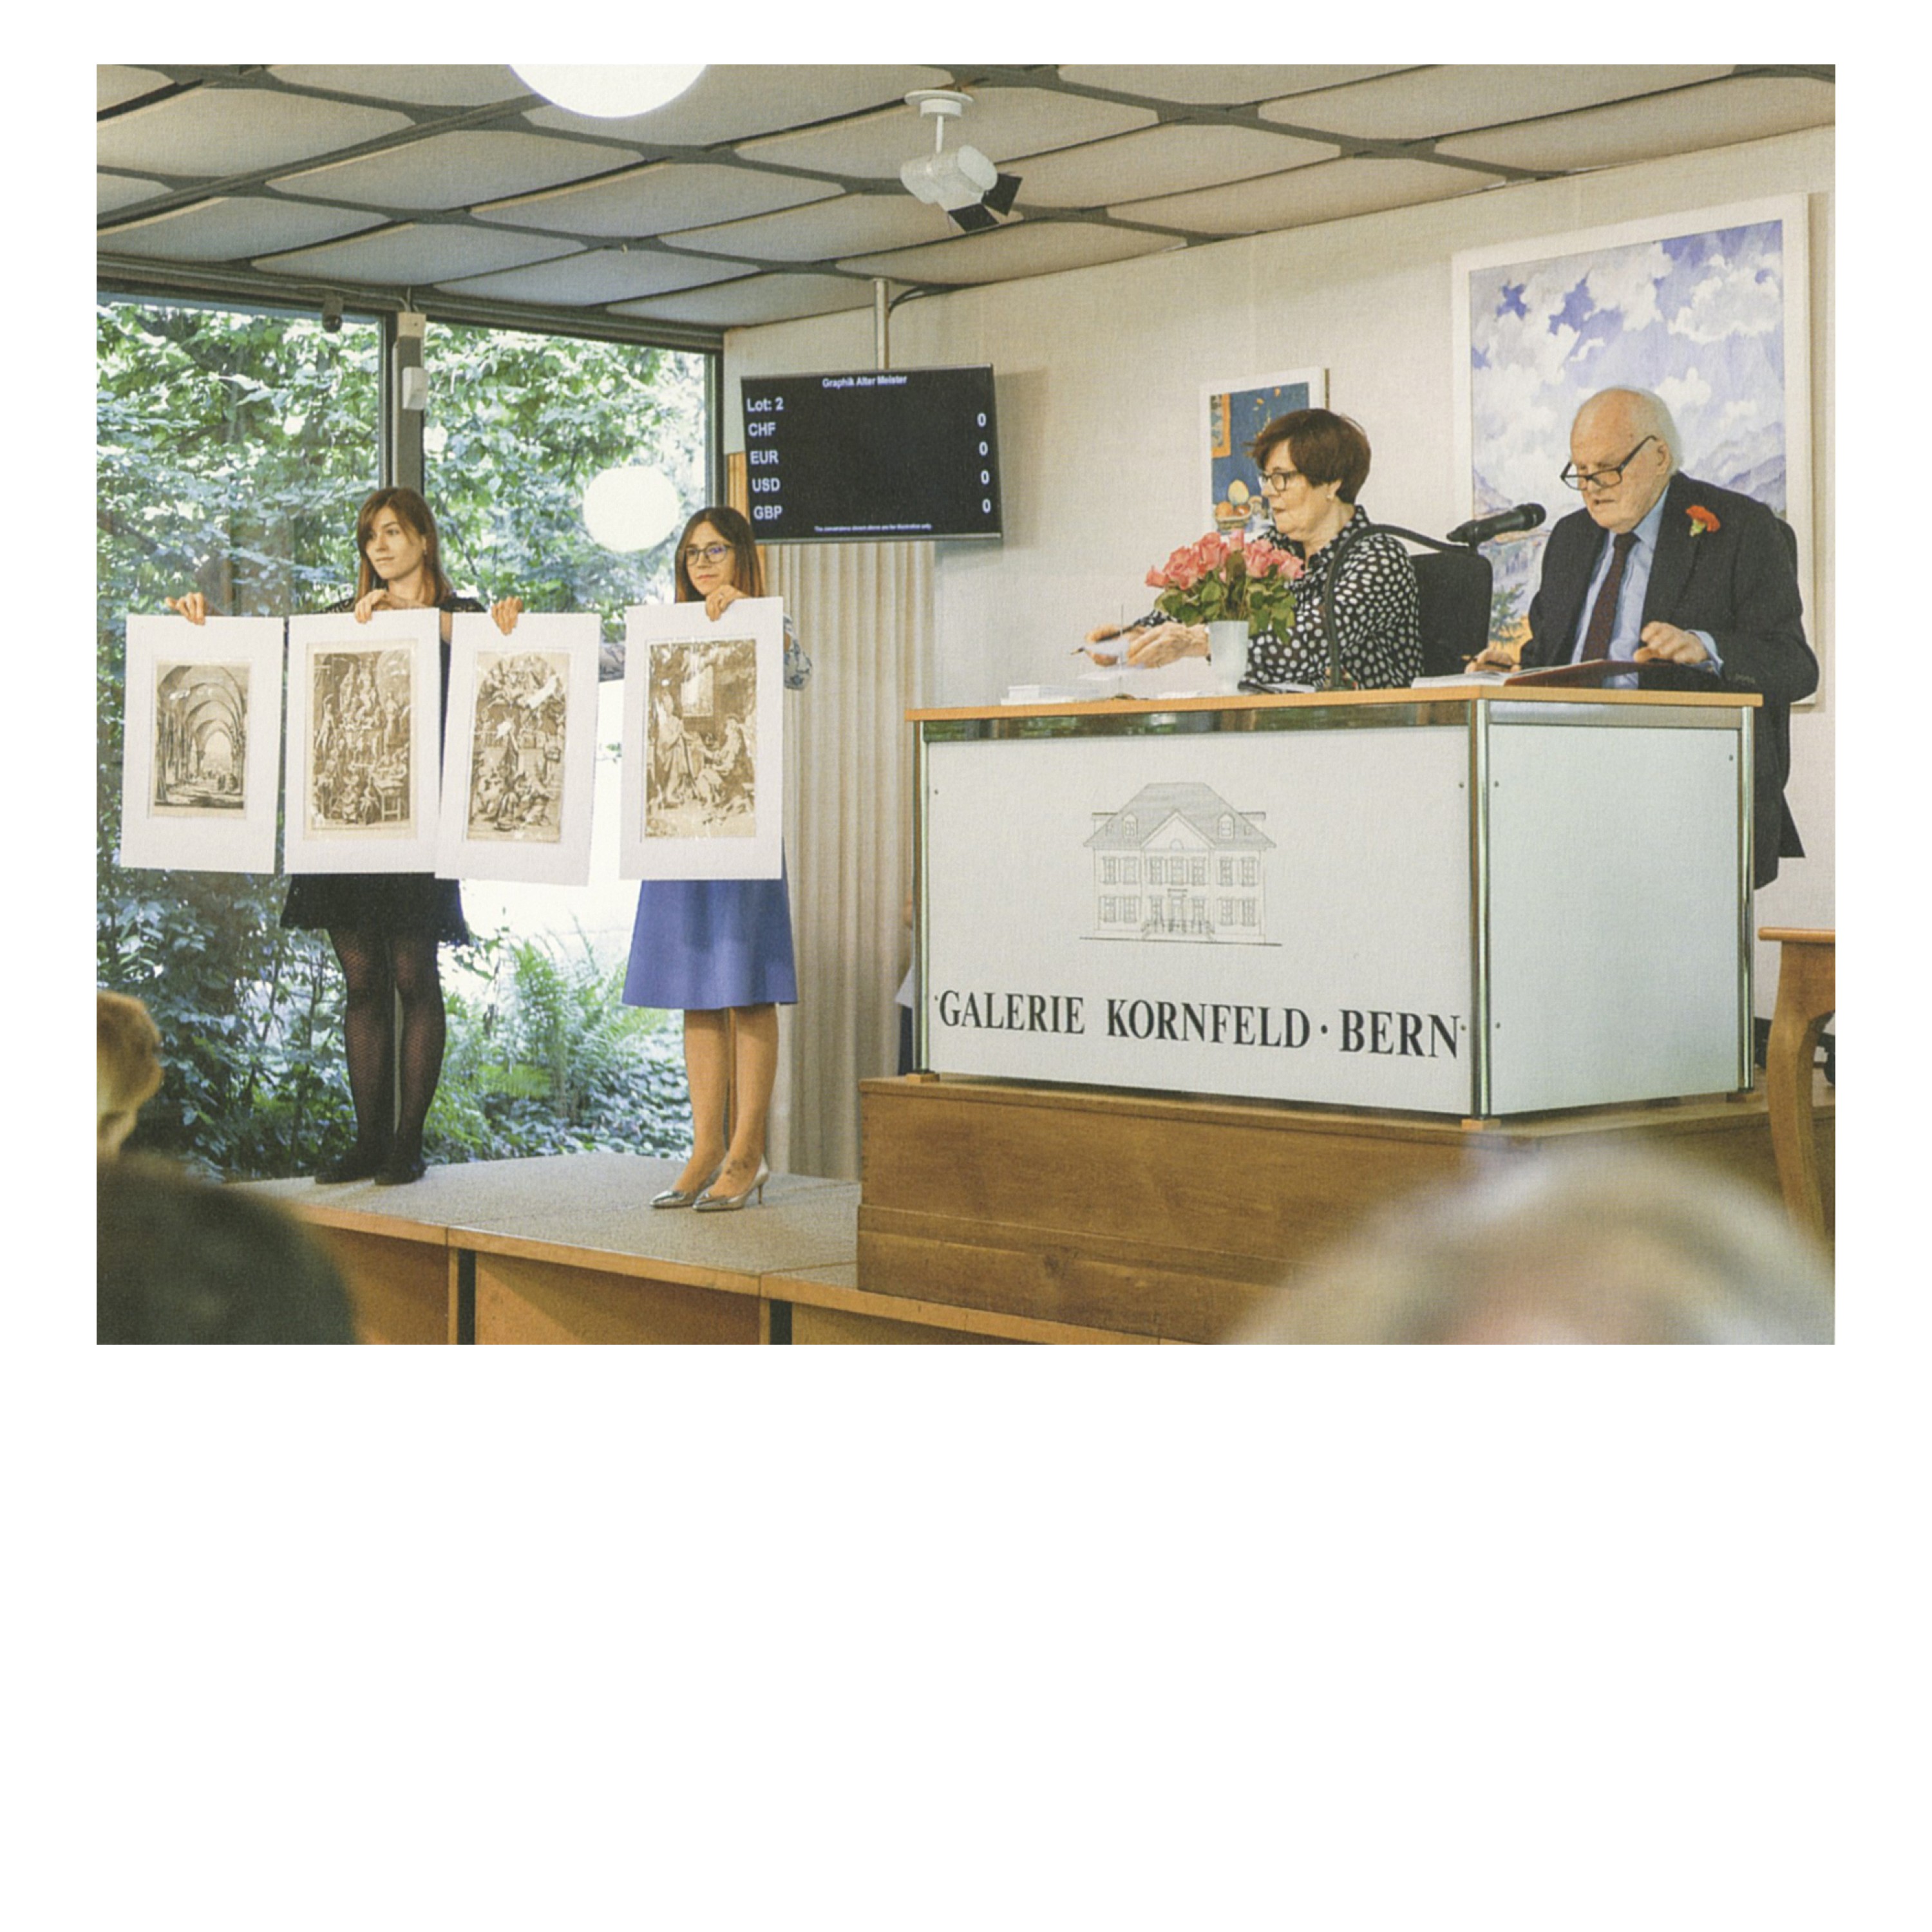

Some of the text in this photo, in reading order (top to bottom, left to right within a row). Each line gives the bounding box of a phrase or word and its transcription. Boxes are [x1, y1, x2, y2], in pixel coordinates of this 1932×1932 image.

[822, 375, 907, 389] Graphik Alter Meister
[746, 397, 784, 412] Lot: 2
[748, 412, 987, 437] CHF 0
[750, 441, 989, 464] EUR 0
[752, 469, 990, 492] USD 0
[753, 498, 991, 520] GBP 0
[939, 990, 1085, 1034] GALERIE
[1107, 999, 1311, 1048] KORNFELD
[1340, 1009, 1460, 1059] BERN
